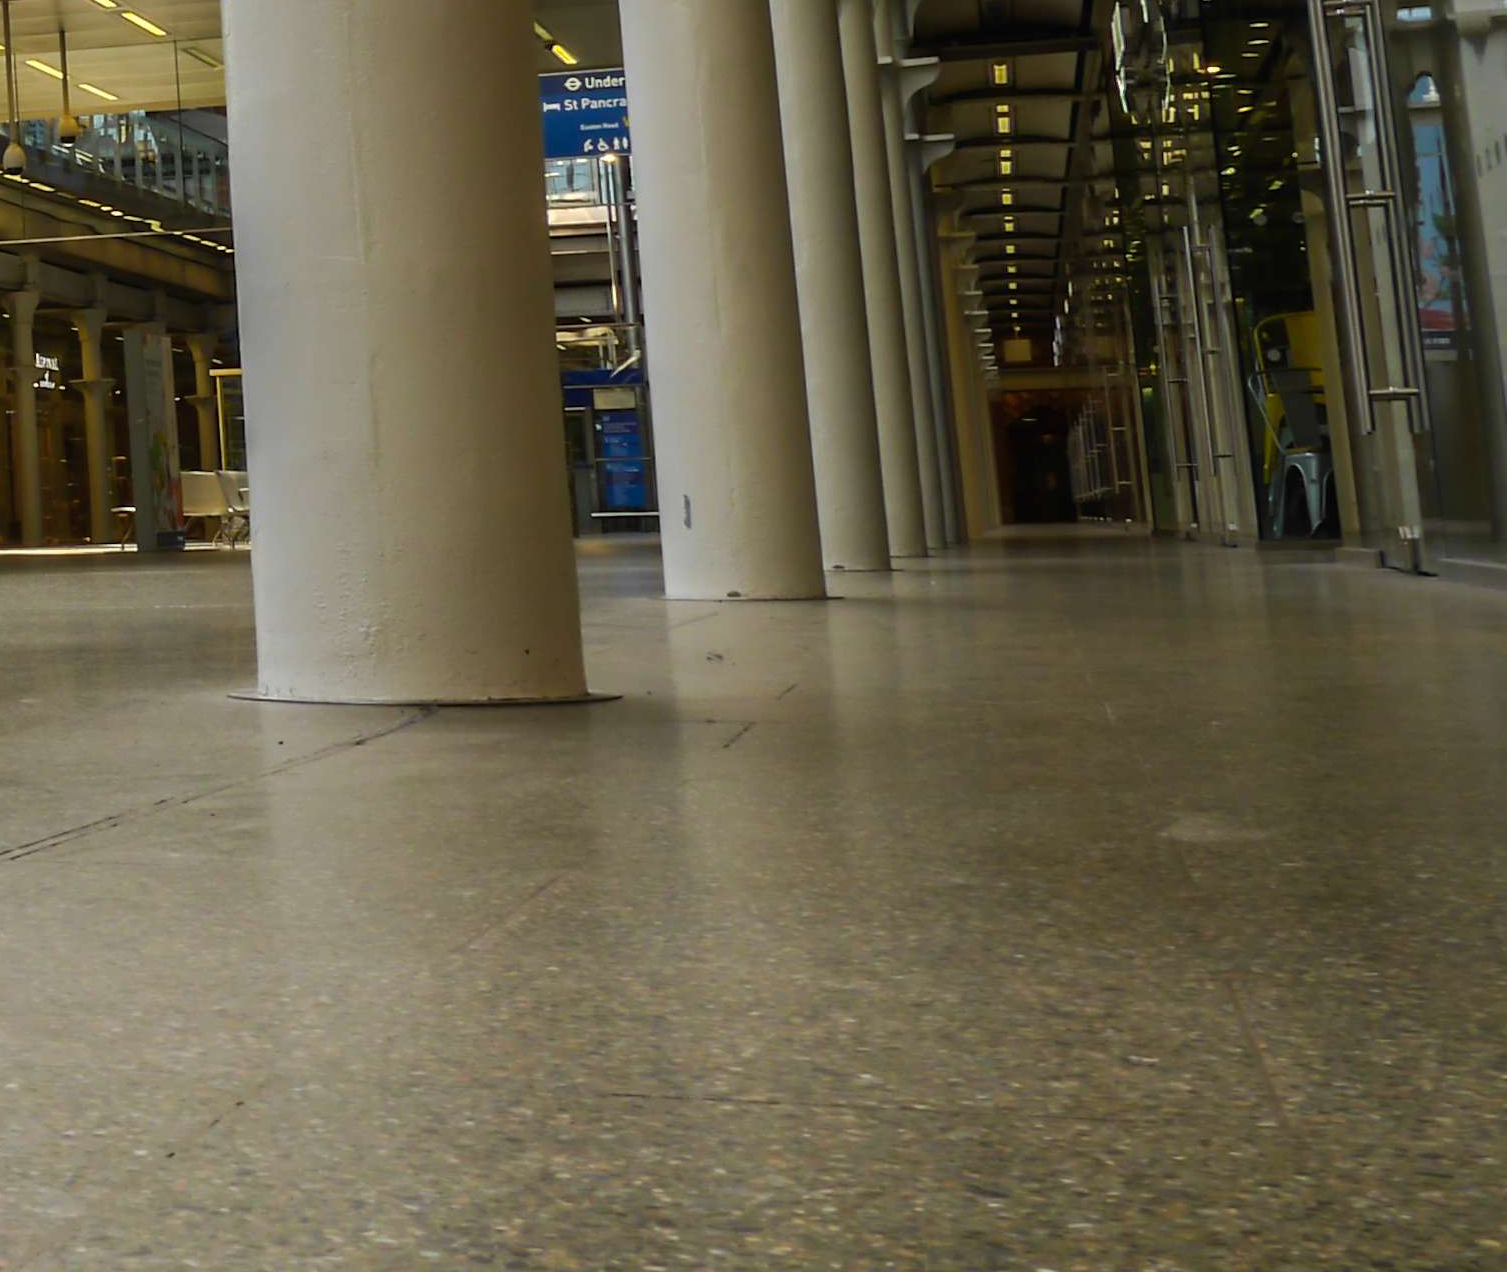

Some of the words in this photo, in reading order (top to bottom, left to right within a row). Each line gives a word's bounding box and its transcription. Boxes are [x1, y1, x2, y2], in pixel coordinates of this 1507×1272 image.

[585, 75, 625, 89] Under
[564, 99, 579, 111] St
[581, 97, 627, 110] Pancra
